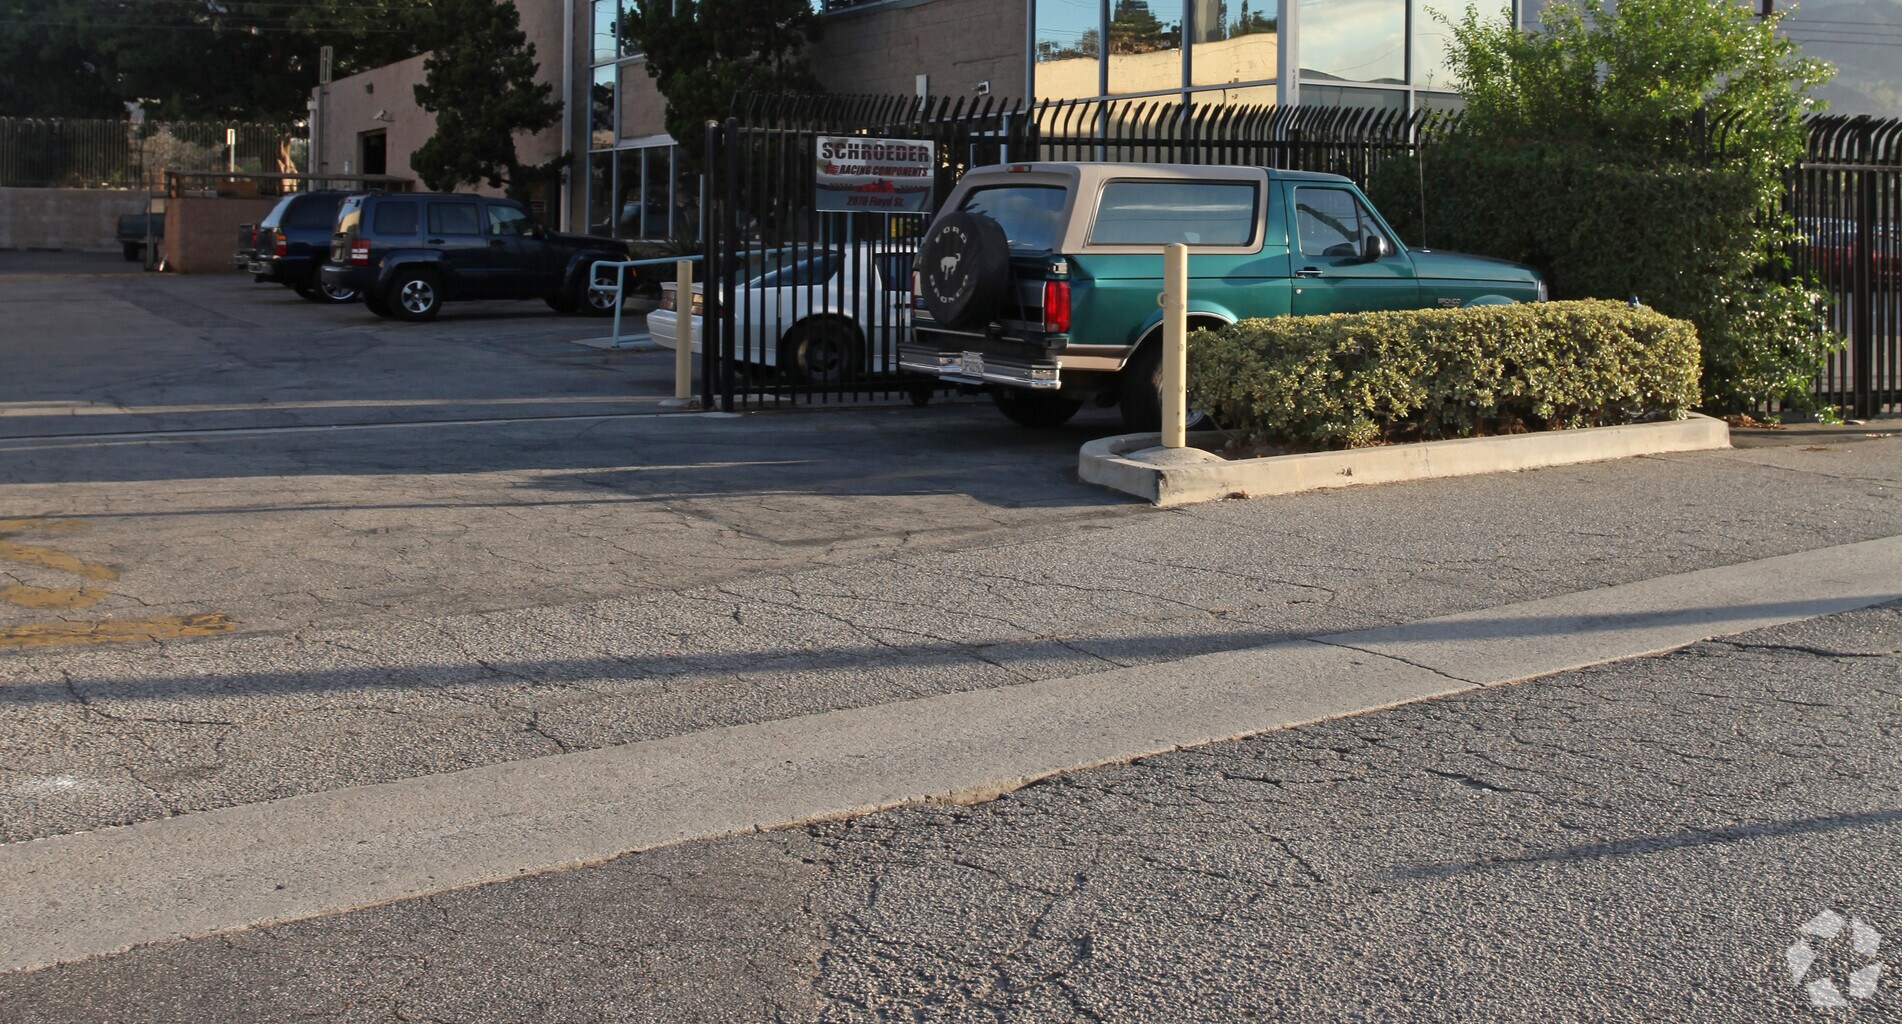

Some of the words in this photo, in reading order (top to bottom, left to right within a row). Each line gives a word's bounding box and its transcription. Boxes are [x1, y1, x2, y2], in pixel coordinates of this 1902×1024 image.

[822, 142, 929, 162] SCHROEDER
[839, 164, 872, 176] RACING
[873, 165, 928, 177] COMPONENTS
